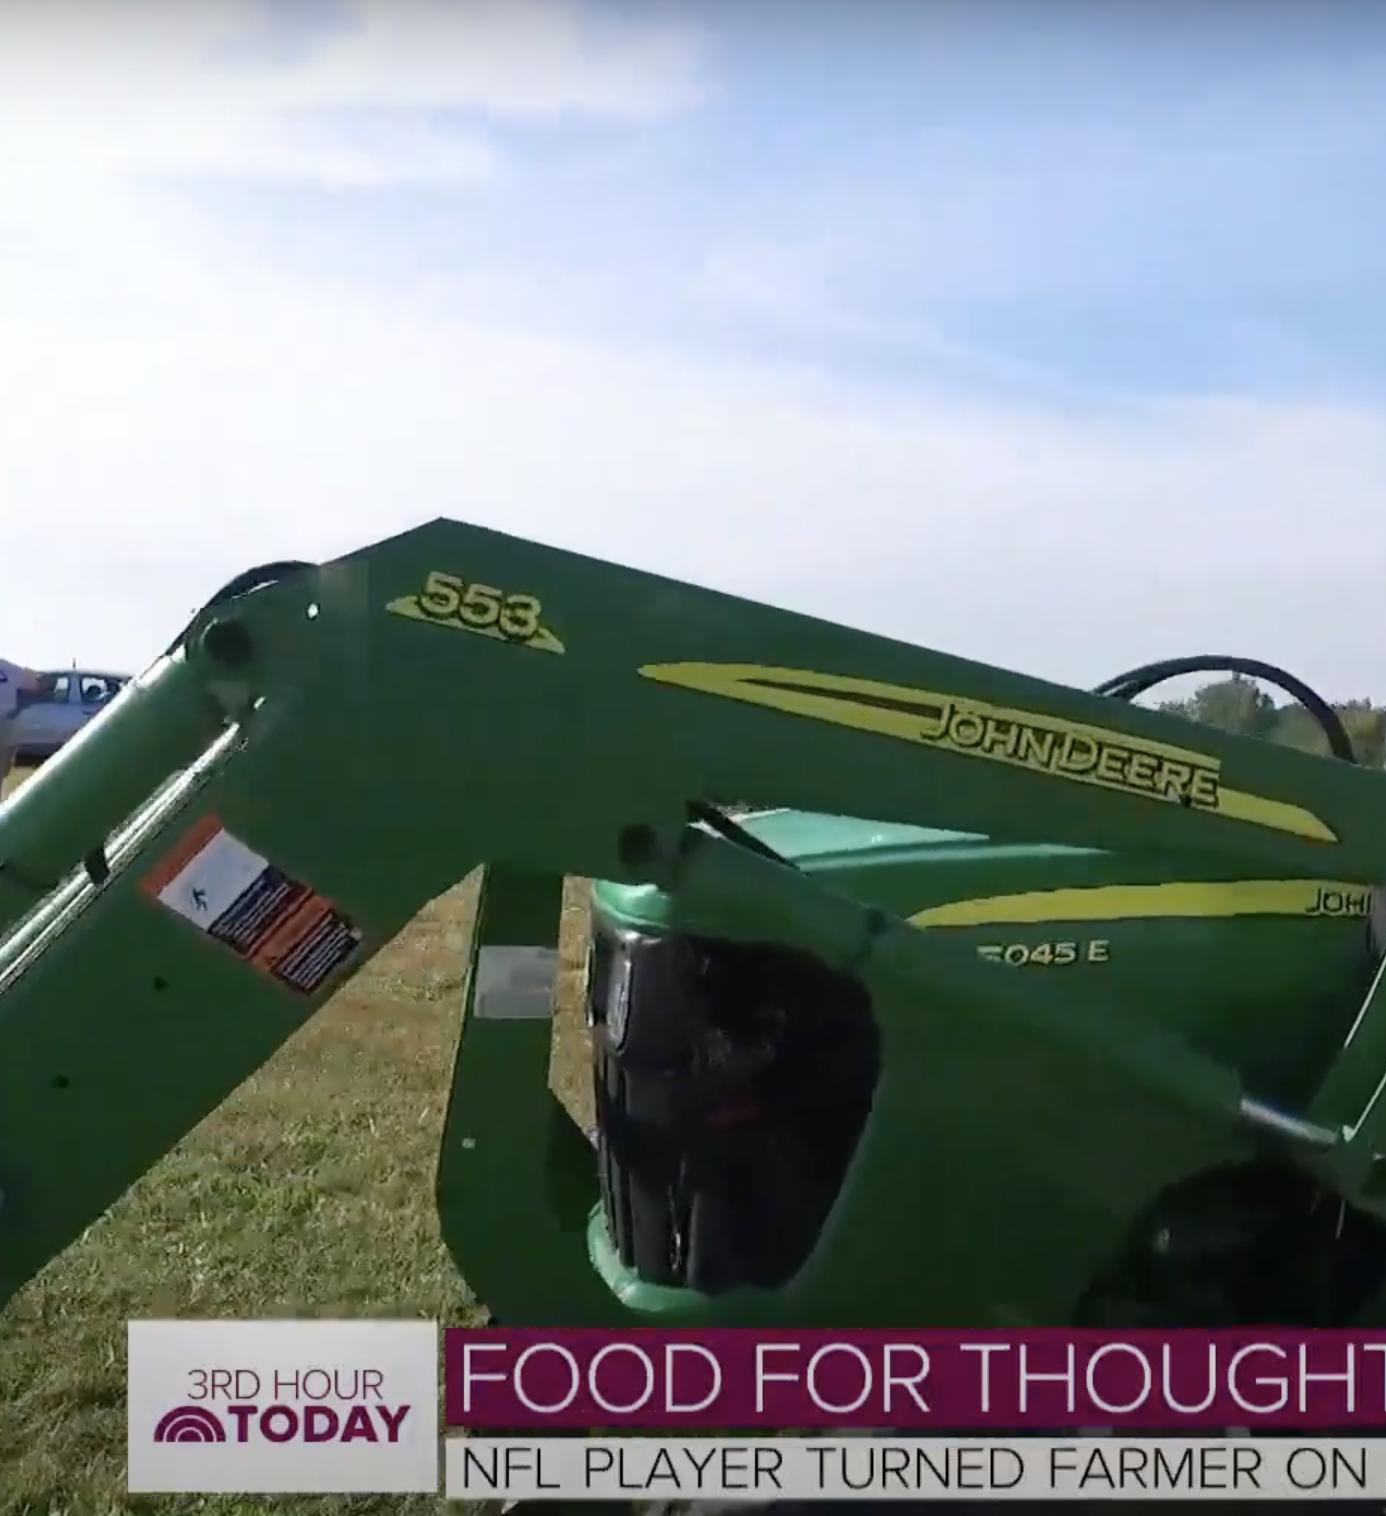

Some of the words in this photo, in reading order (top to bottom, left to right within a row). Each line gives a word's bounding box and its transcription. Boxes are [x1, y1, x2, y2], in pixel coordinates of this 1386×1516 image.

[419, 571, 542, 642] 553
[920, 703, 1056, 771] JOHN
[1058, 731, 1220, 808] DEERE
